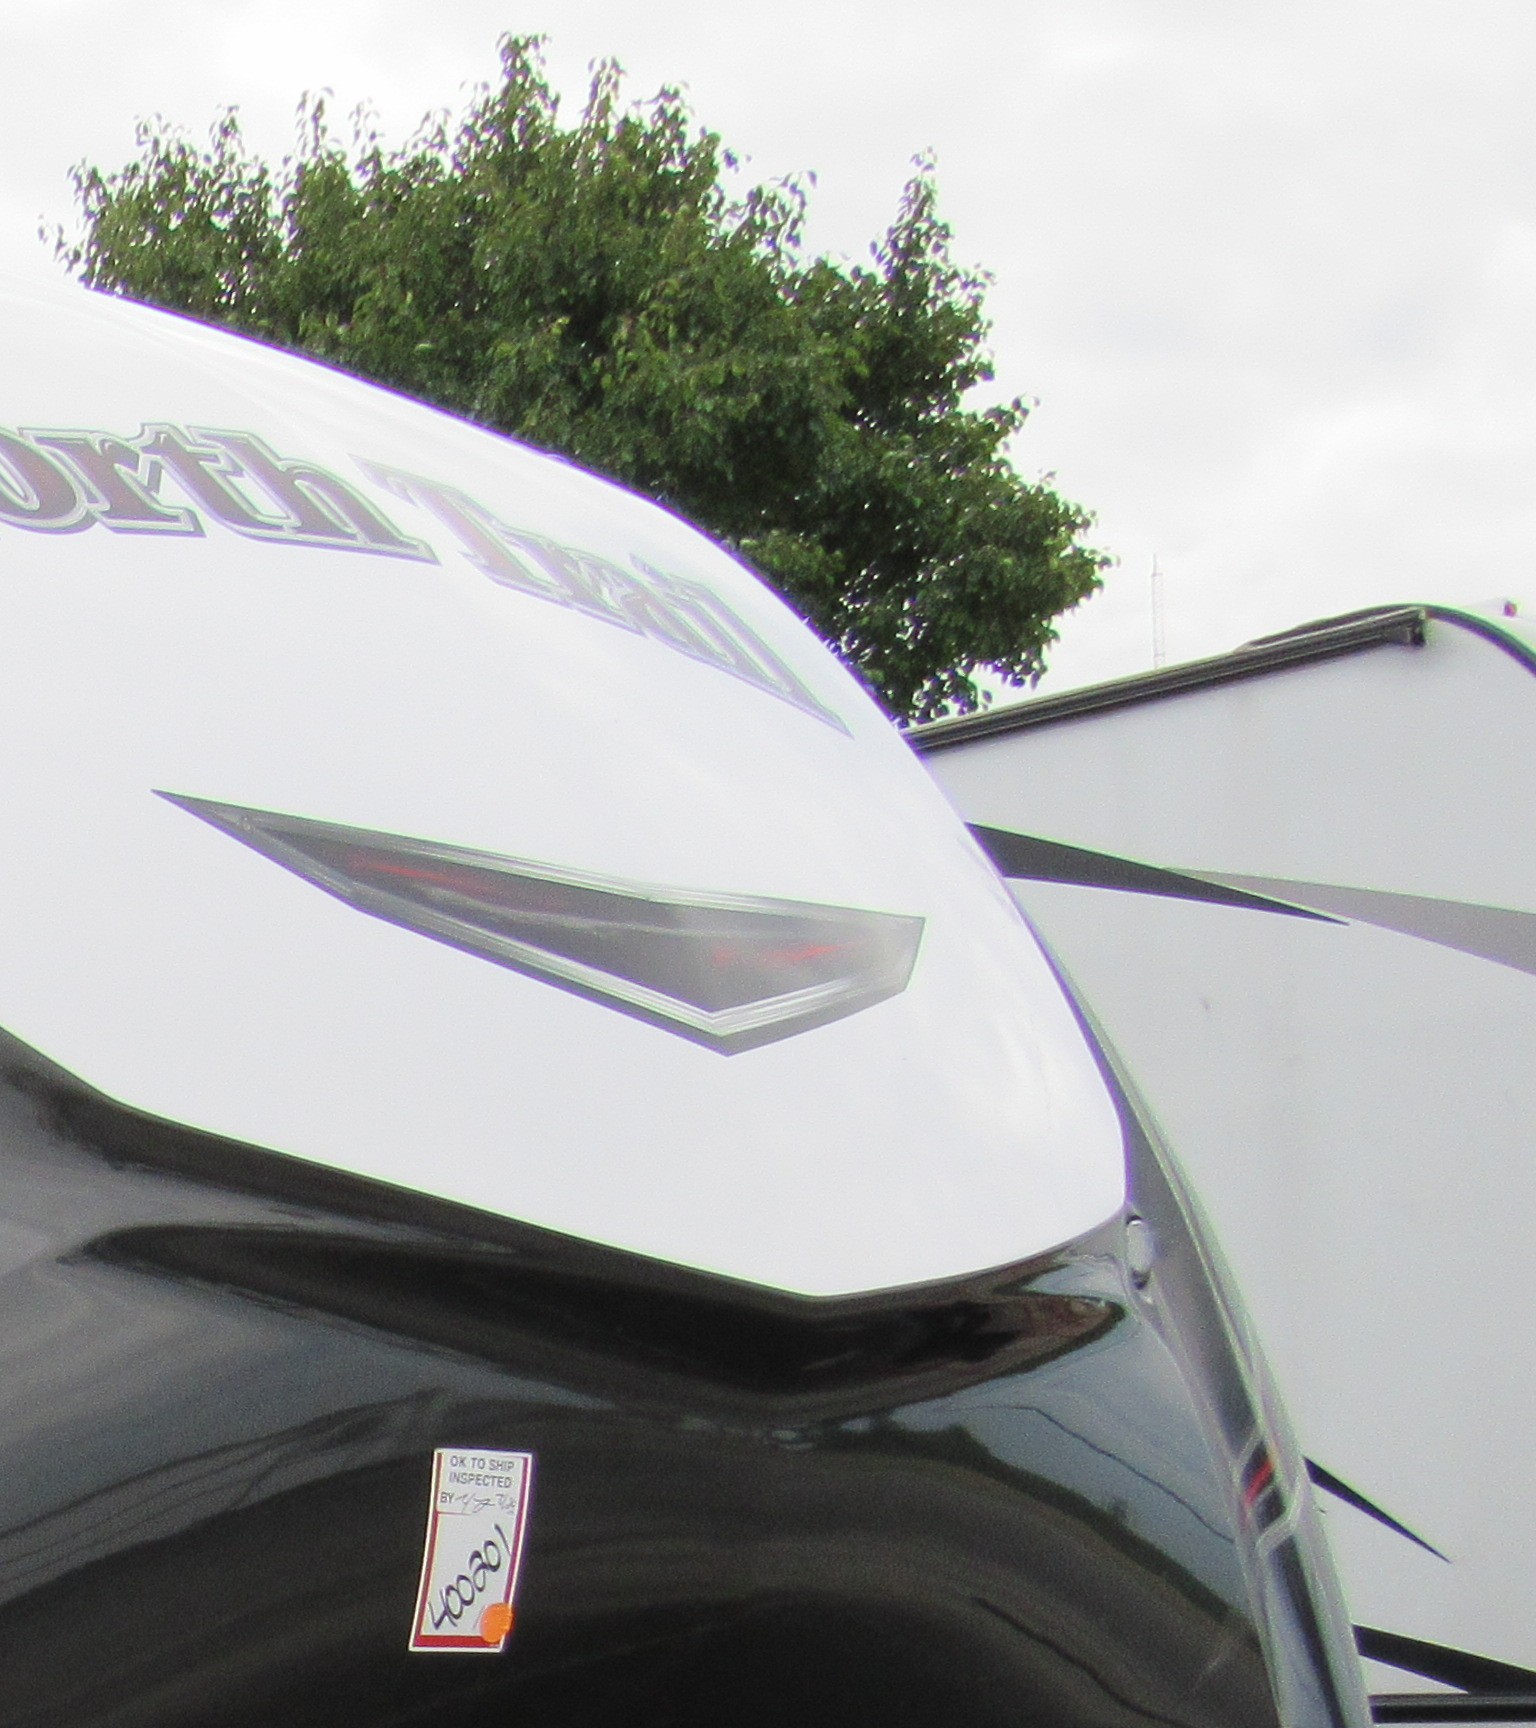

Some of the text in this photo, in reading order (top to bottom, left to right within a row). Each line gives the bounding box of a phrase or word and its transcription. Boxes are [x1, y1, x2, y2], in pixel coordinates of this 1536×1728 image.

[347, 453, 854, 739] Trail
[449, 1455, 515, 1472] OK TO SHIP
[448, 1471, 512, 1489] INSPECTED
[440, 1491, 455, 1504] BY
